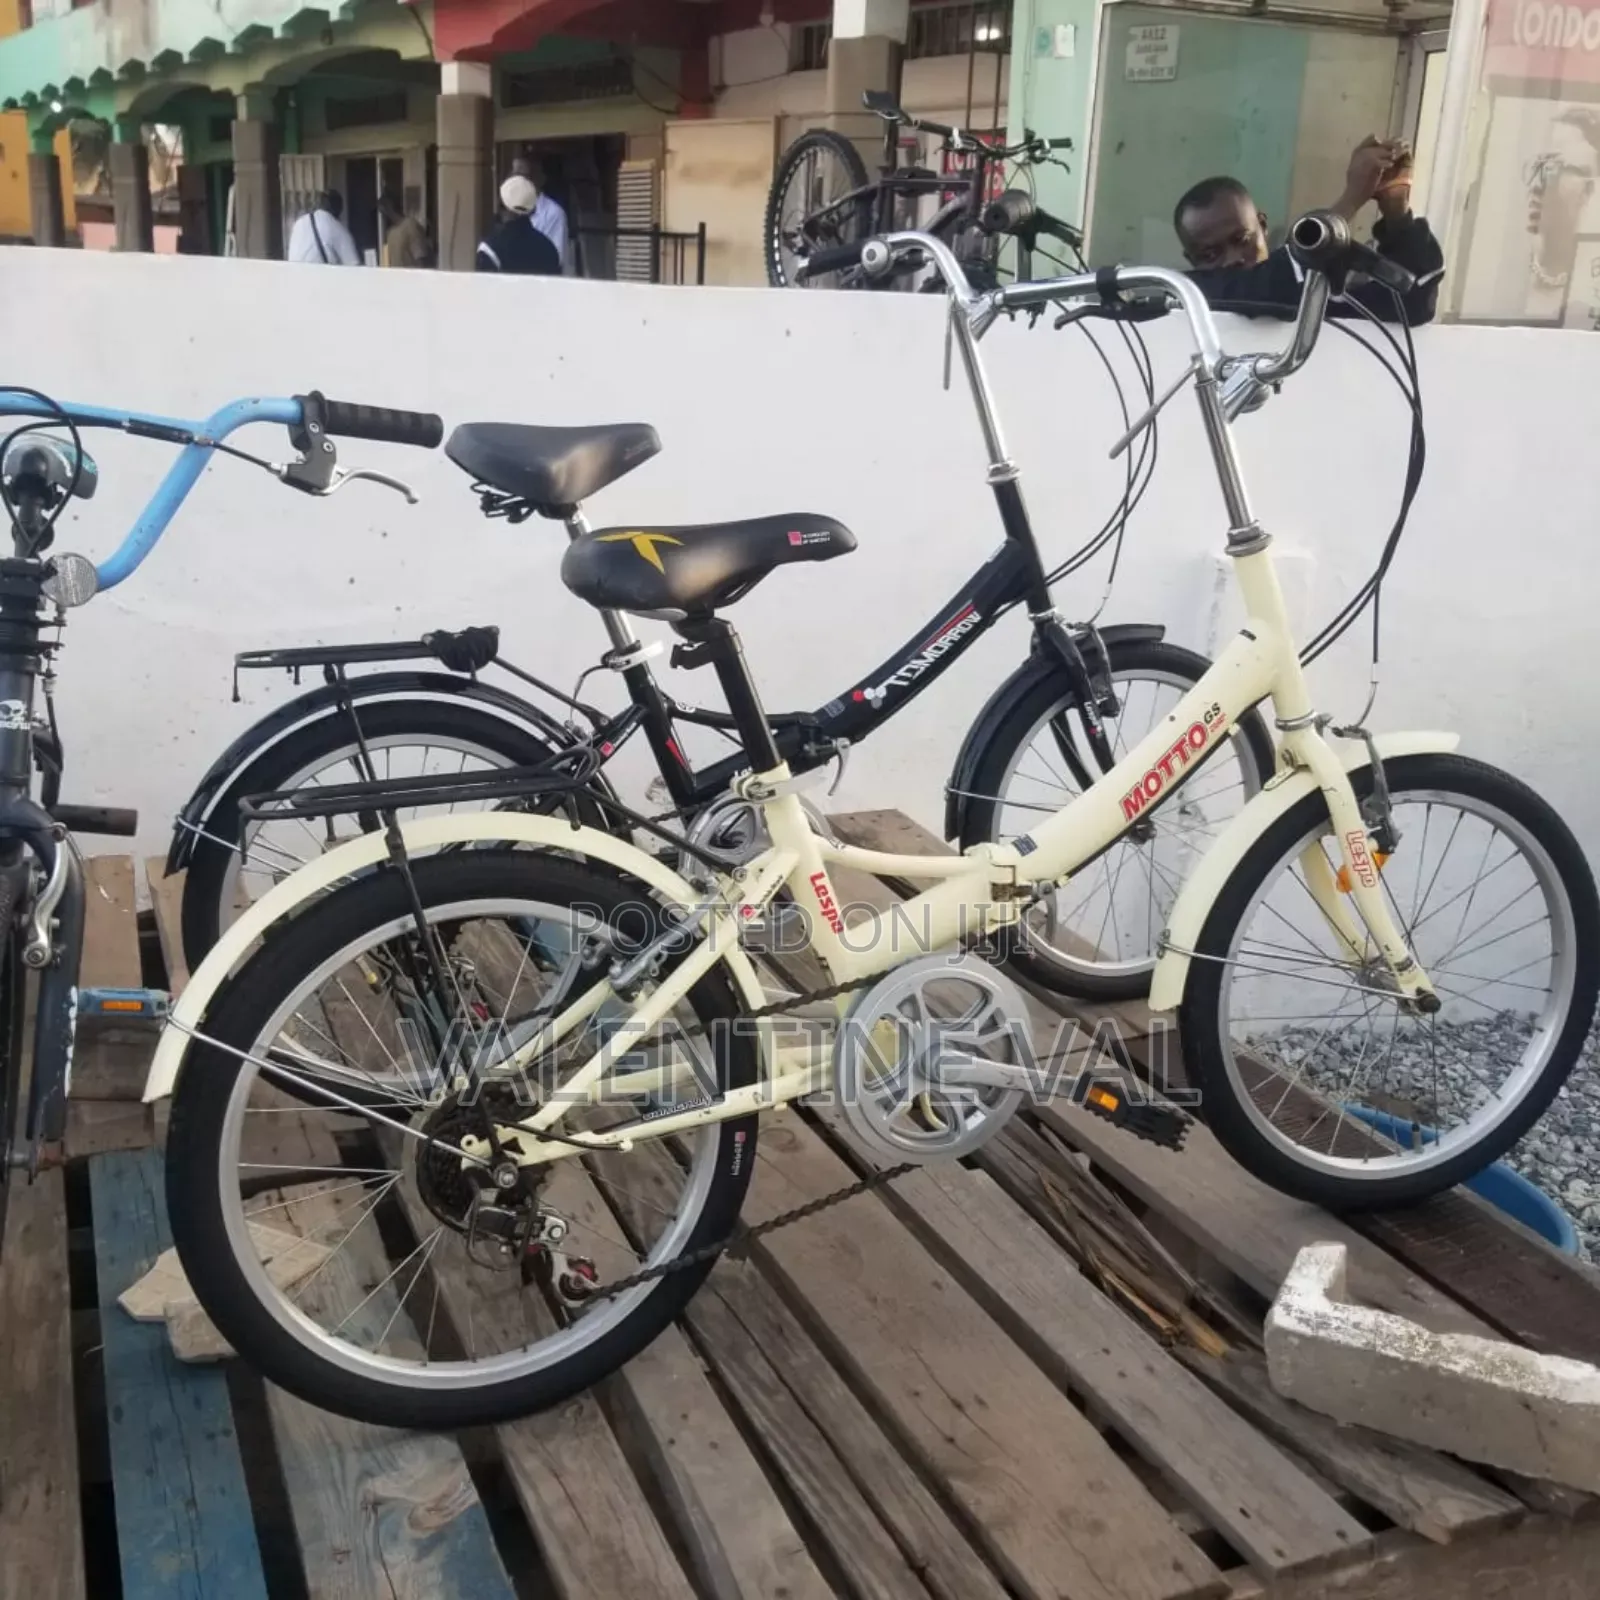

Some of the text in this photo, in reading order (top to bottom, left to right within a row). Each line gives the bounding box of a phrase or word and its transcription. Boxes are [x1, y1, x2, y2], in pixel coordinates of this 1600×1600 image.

[884, 611, 982, 687] TOMORROW
[1119, 702, 1221, 822] MOTTO GS
[1346, 830, 1377, 889] Lespo
[809, 871, 845, 934] Lespo
